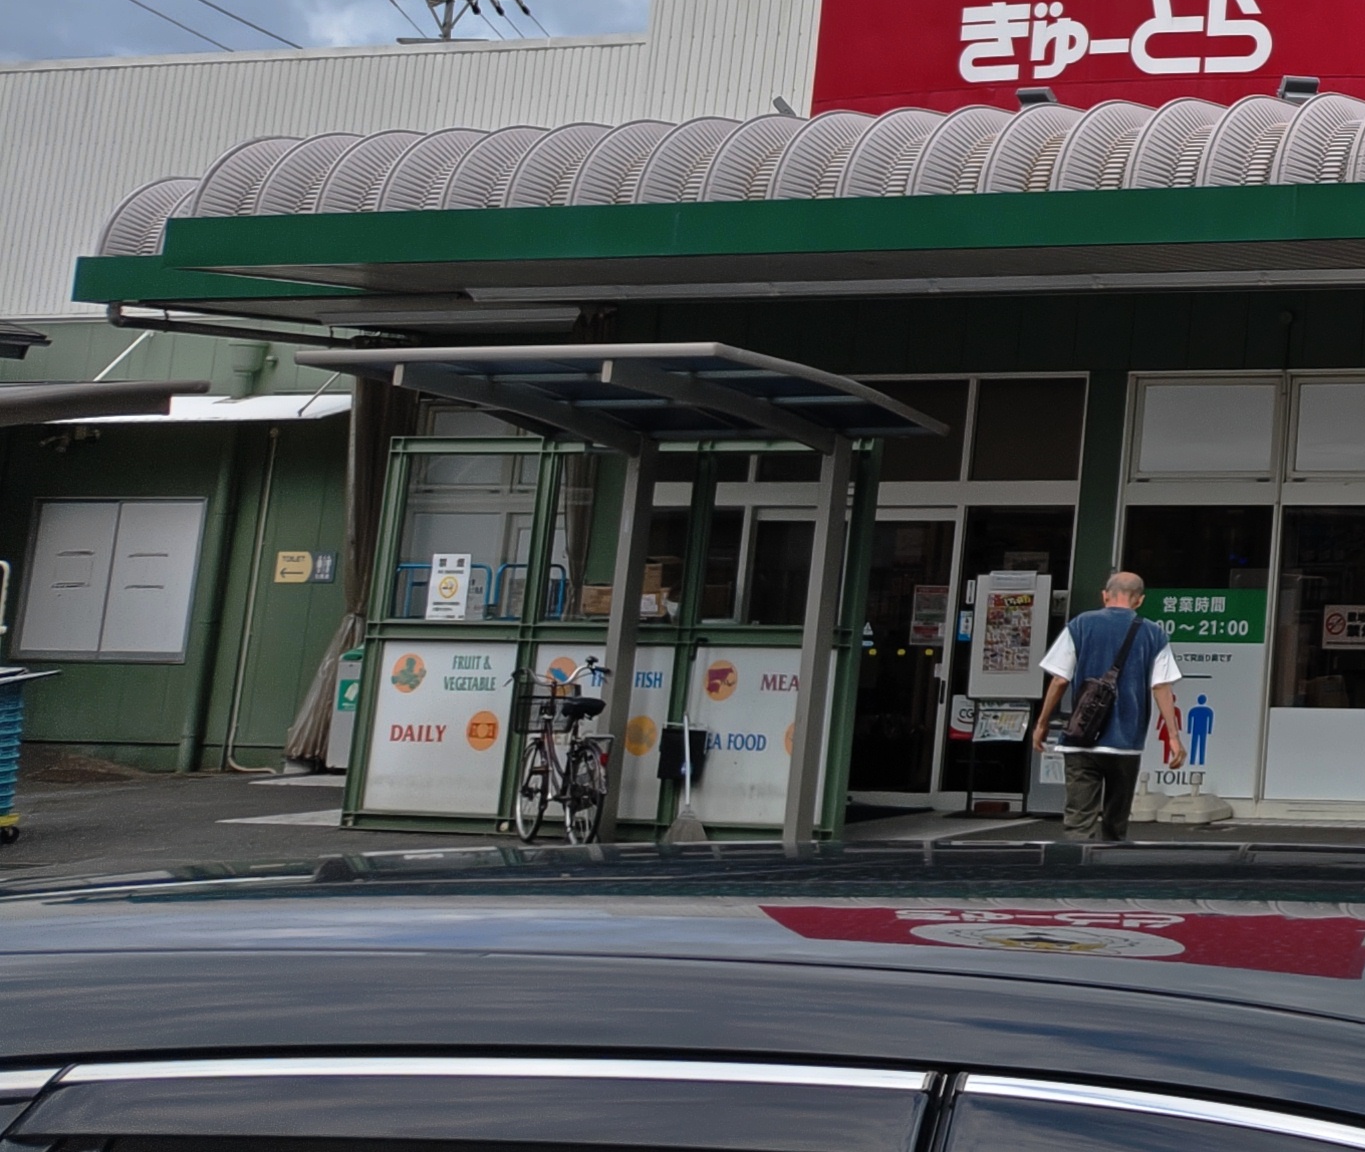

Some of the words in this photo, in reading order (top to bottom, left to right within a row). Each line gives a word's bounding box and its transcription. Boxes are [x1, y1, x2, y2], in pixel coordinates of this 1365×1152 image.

[1163, 596, 1226, 613] 営業時間
[452, 655, 481, 670] FRUIT
[483, 655, 492, 670] &
[443, 676, 496, 692] VEGETABLE
[634, 671, 663, 689] FISH
[760, 674, 800, 691] MEA
[390, 724, 447, 742] DAILY
[727, 733, 767, 752] FOOD
